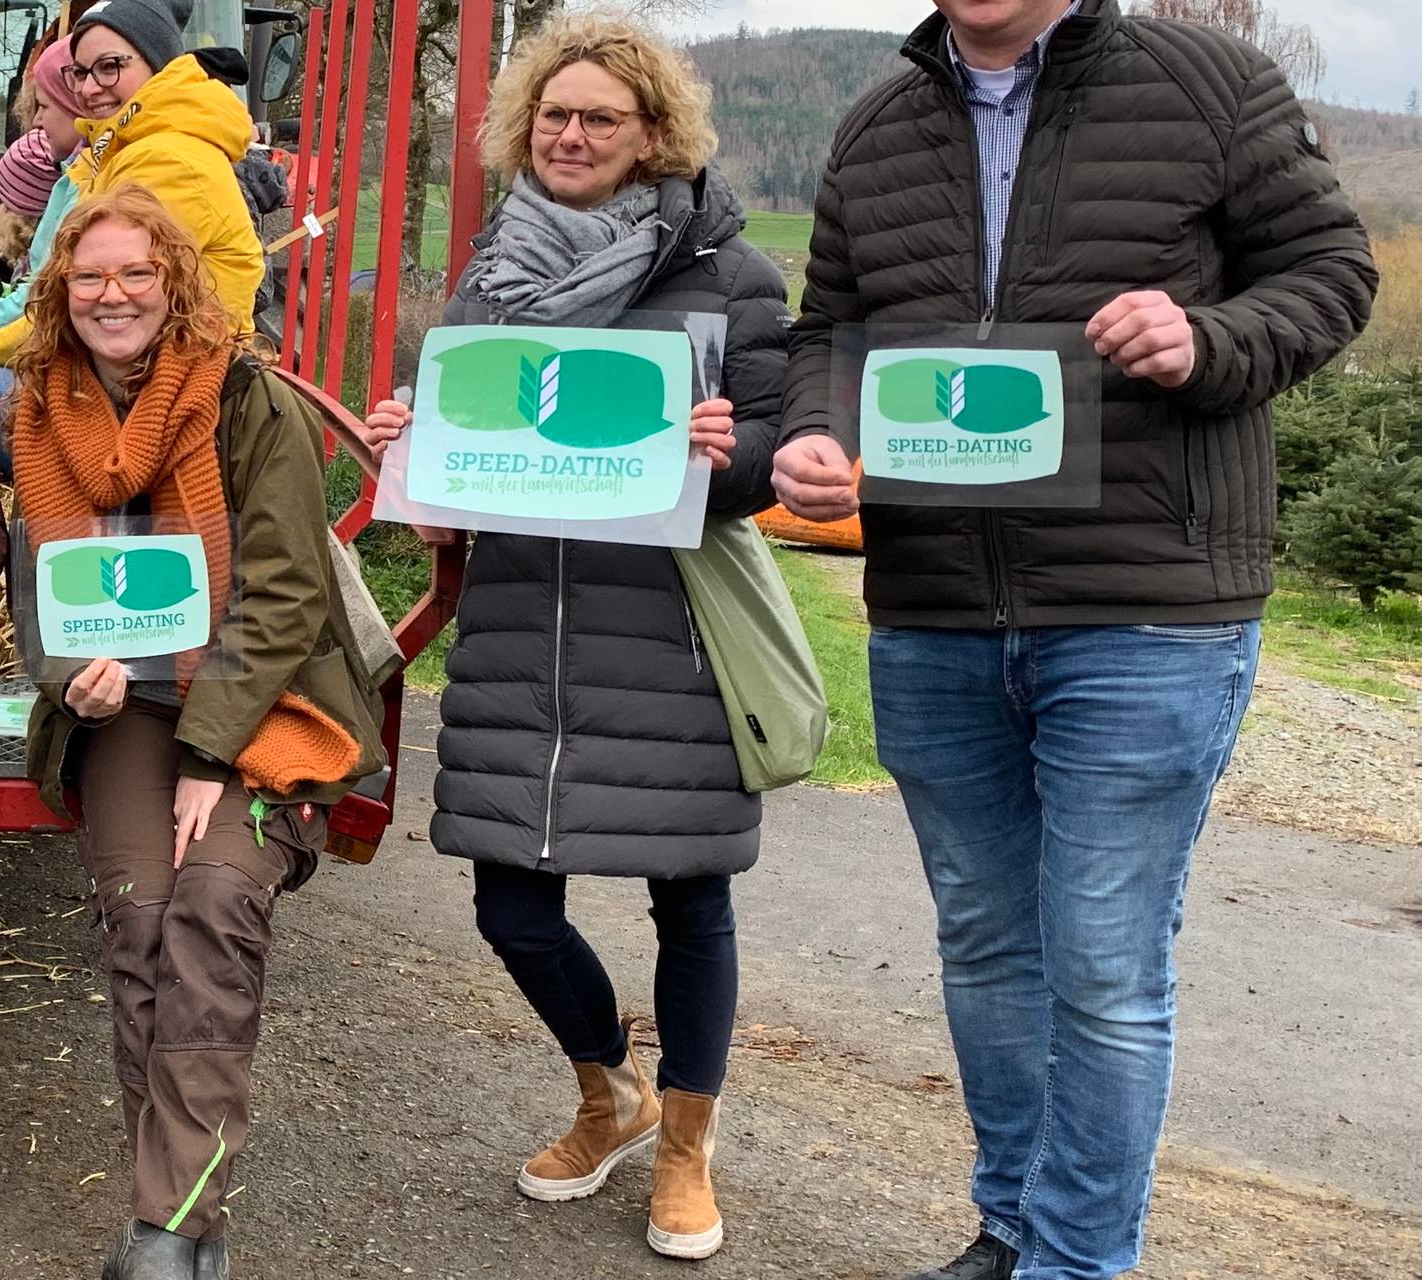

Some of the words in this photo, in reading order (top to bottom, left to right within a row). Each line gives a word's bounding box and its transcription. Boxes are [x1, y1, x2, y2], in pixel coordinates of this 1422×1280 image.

[887, 438, 1032, 453] SPEED-DATING
[445, 452, 643, 478] SPEED-DATING
[471, 476, 496, 494] mit
[497, 474, 519, 494] der
[521, 471, 624, 498] Landwirtschaft
[63, 613, 186, 633] SPEED-DATING
